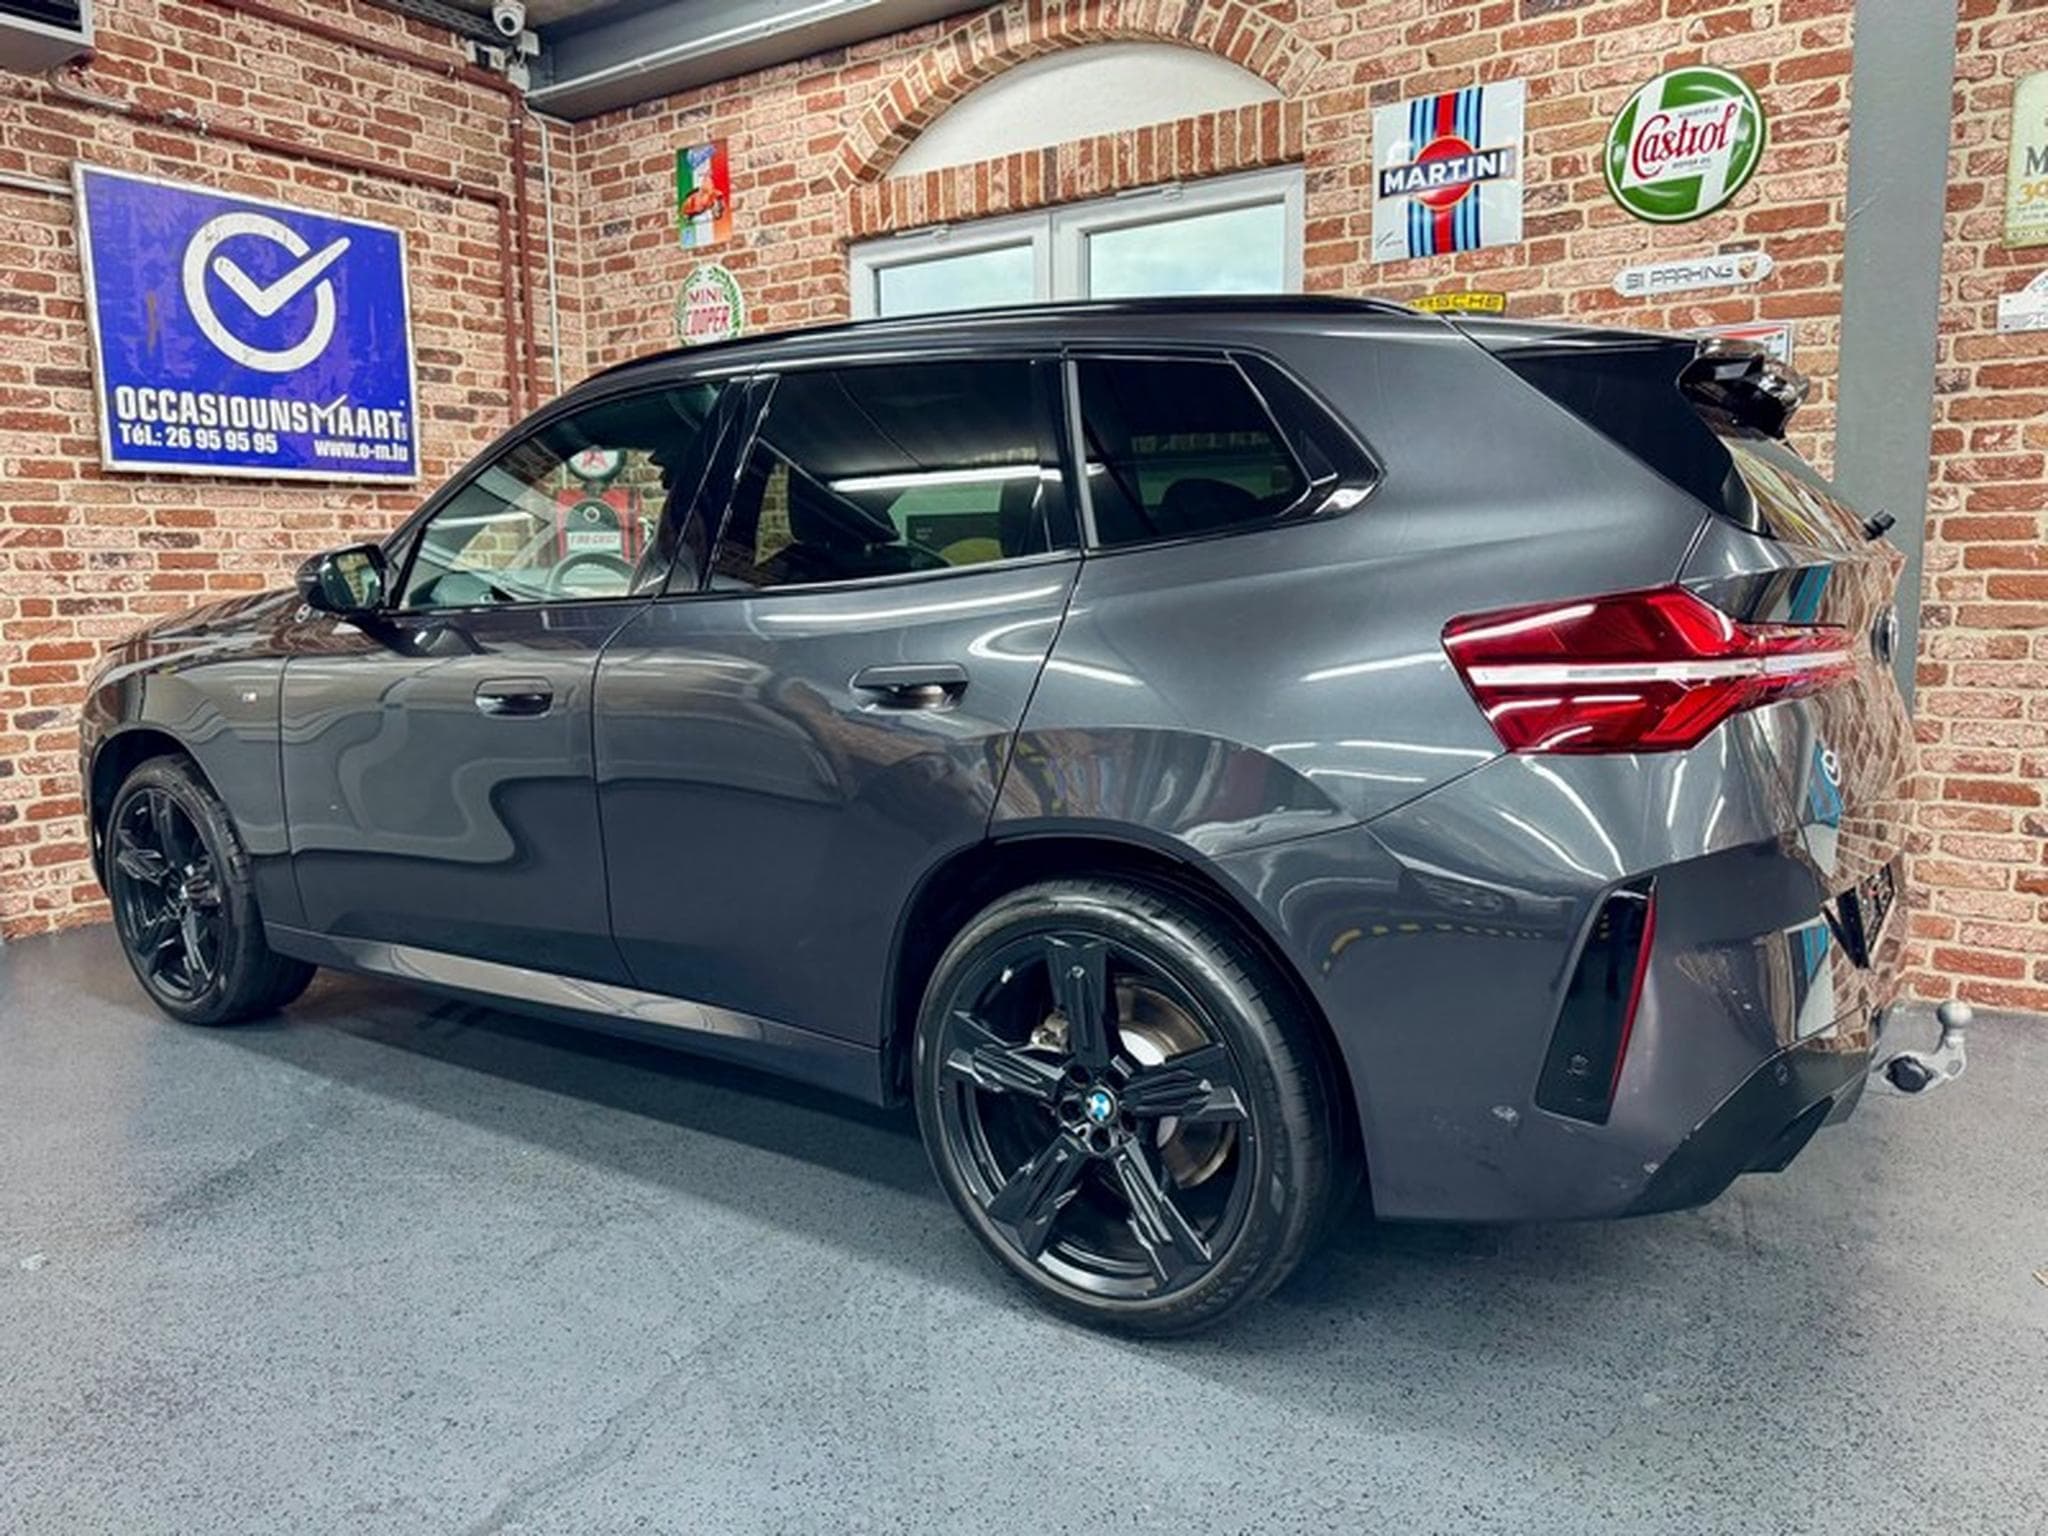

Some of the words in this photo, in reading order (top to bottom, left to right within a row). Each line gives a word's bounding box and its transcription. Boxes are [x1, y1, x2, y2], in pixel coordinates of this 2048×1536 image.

[1632, 102, 1738, 179] Castrol
[1383, 151, 1507, 194] MARTINI
[1650, 264, 1734, 284] PARKING
[687, 288, 723, 304] MINI
[1407, 296, 1500, 309] RSCHE
[685, 305, 730, 336] COOPER
[115, 385, 403, 440] OCCASIOUNSMAART
[165, 425, 193, 449] 26
[195, 427, 222, 451] 95
[224, 429, 250, 453] 95
[252, 431, 278, 455] 95
[314, 439, 408, 462] www.o-m.lu
